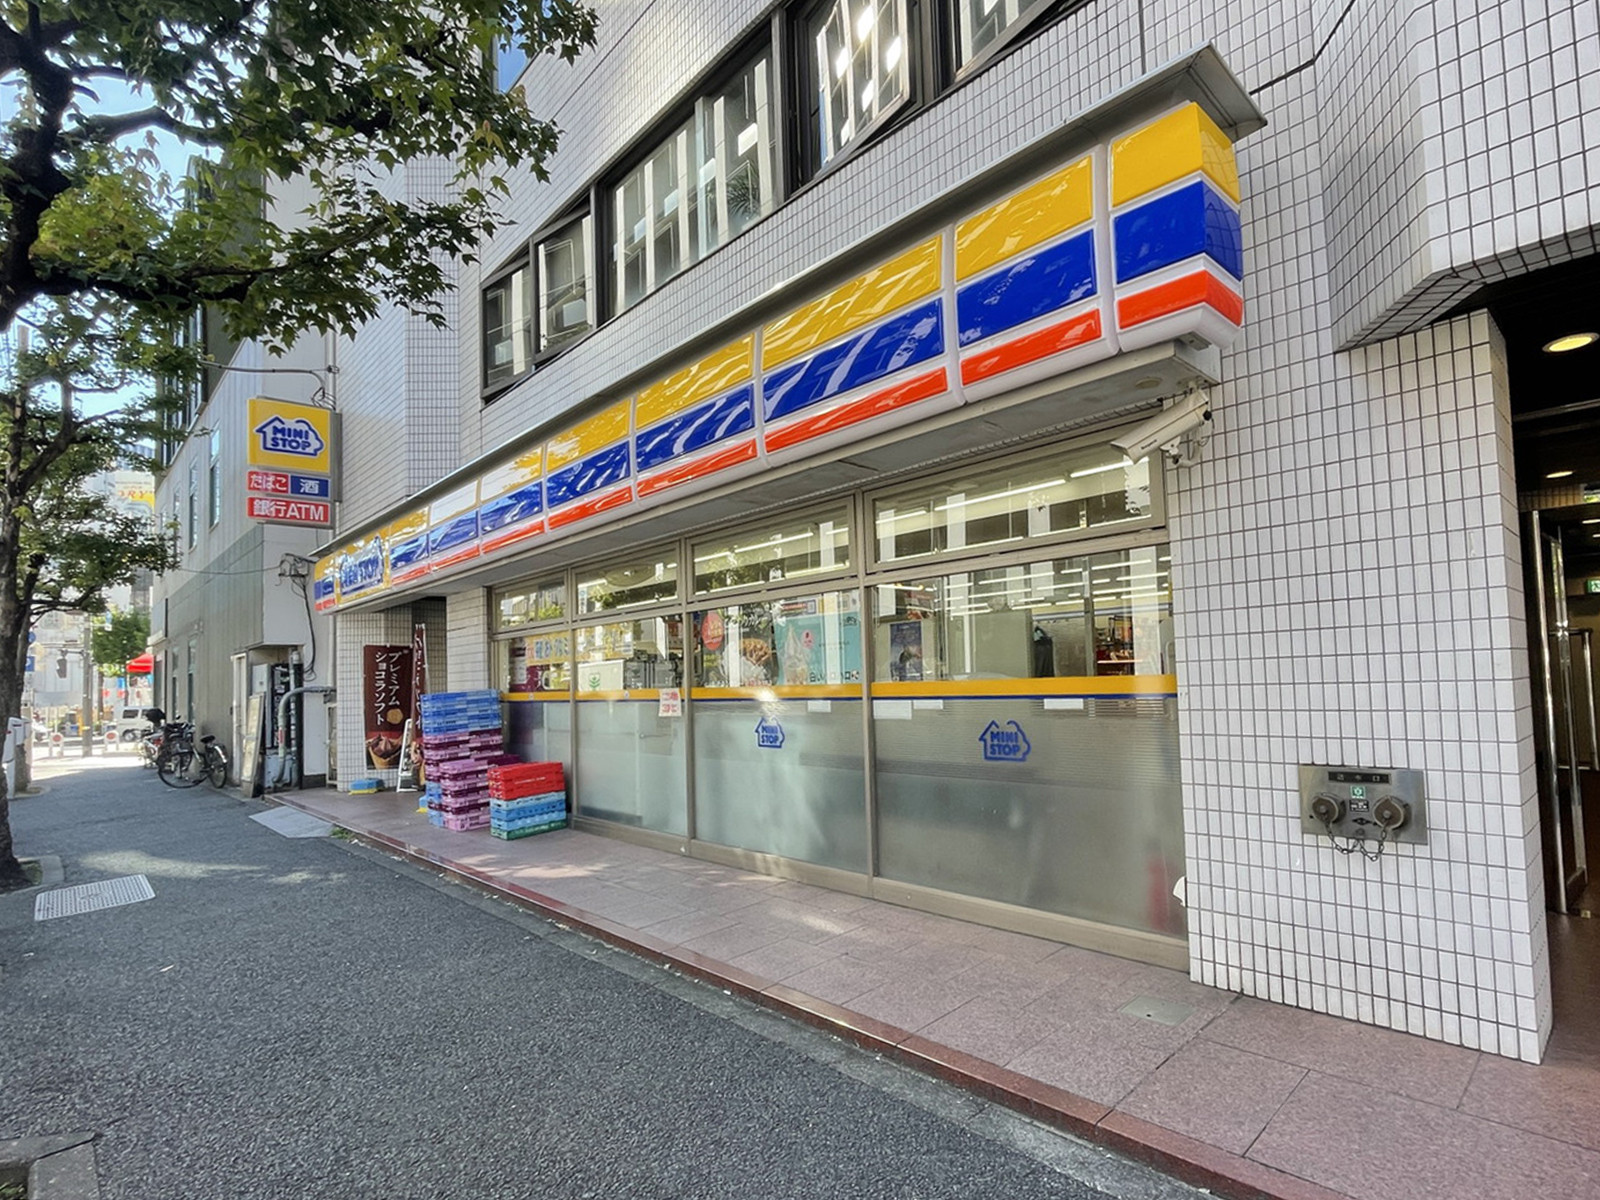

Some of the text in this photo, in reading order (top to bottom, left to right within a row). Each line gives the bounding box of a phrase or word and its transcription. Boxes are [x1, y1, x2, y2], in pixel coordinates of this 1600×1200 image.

[272, 425, 310, 440] MINI
[270, 436, 312, 451] STOP
[249, 473, 287, 491] たばこ
[299, 478, 320, 494] 酒
[252, 499, 325, 521] 銀行ATM
[387, 651, 402, 706] プレミアム
[374, 651, 388, 726] ショコラソフト
[761, 725, 779, 734] MINI
[990, 731, 1019, 743] MINI
[761, 734, 779, 744] STOP
[990, 743, 1021, 756] STOP
